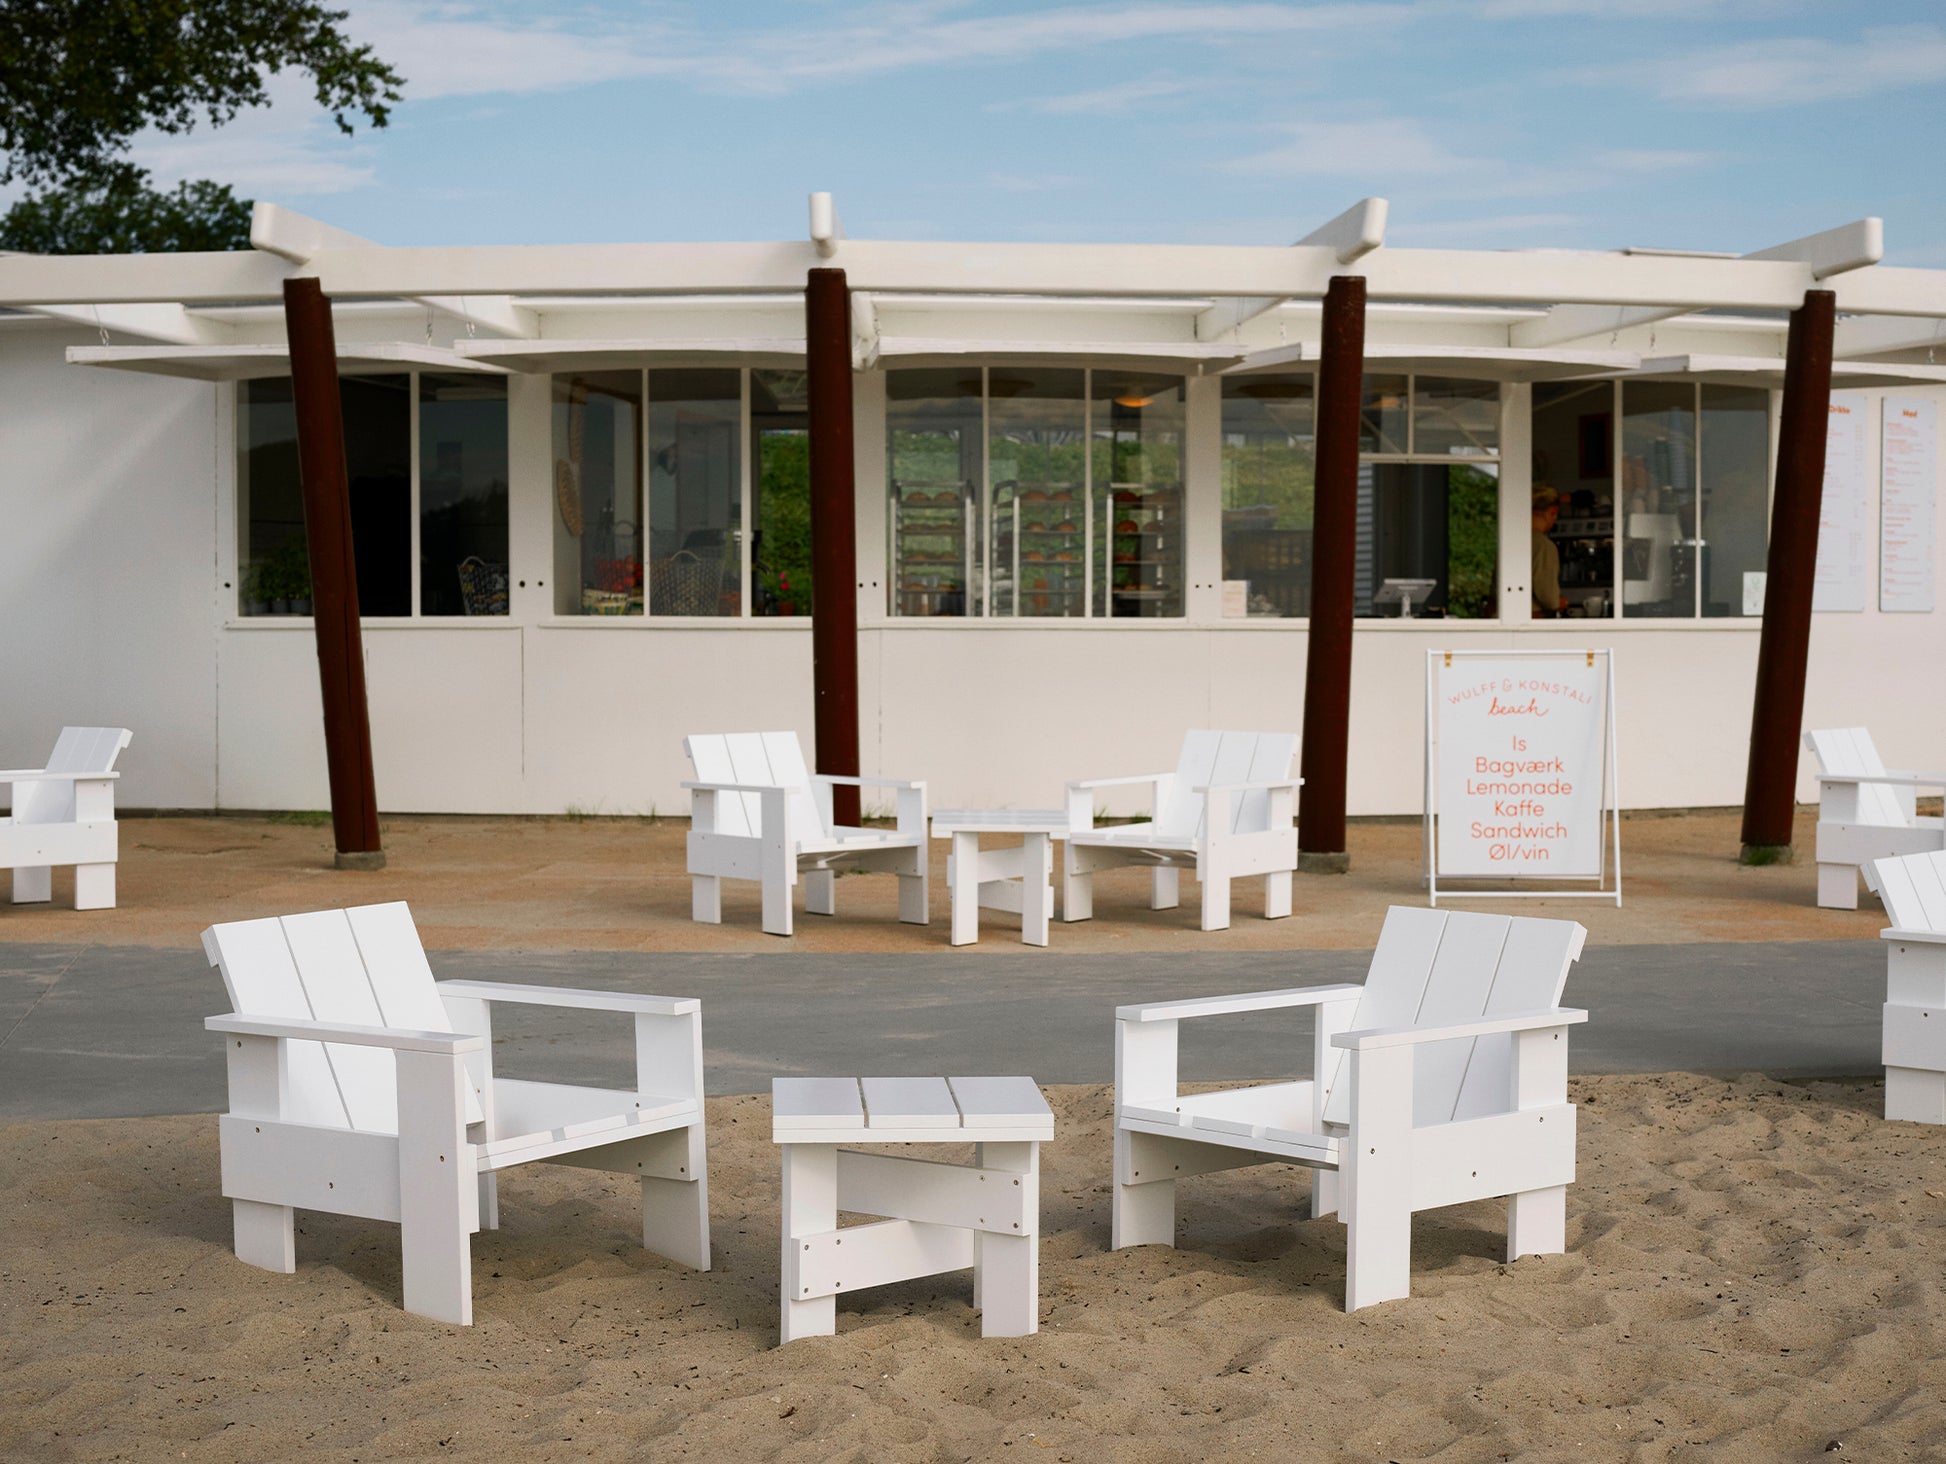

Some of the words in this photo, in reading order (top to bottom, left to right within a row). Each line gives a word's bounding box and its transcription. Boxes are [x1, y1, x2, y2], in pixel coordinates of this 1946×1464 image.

[1448, 681, 1496, 704] WULFF
[1502, 678, 1513, 692] &
[1519, 679, 1592, 704] KONSTALI
[1488, 697, 1549, 717] beach
[1512, 735, 1527, 752] Is
[1475, 756, 1564, 778] Bagværk
[1466, 778, 1573, 796] Lemonade
[1494, 799, 1545, 817] Kaffe
[1471, 821, 1568, 839] Sandwich
[1488, 842, 1550, 861] Øl/vin
